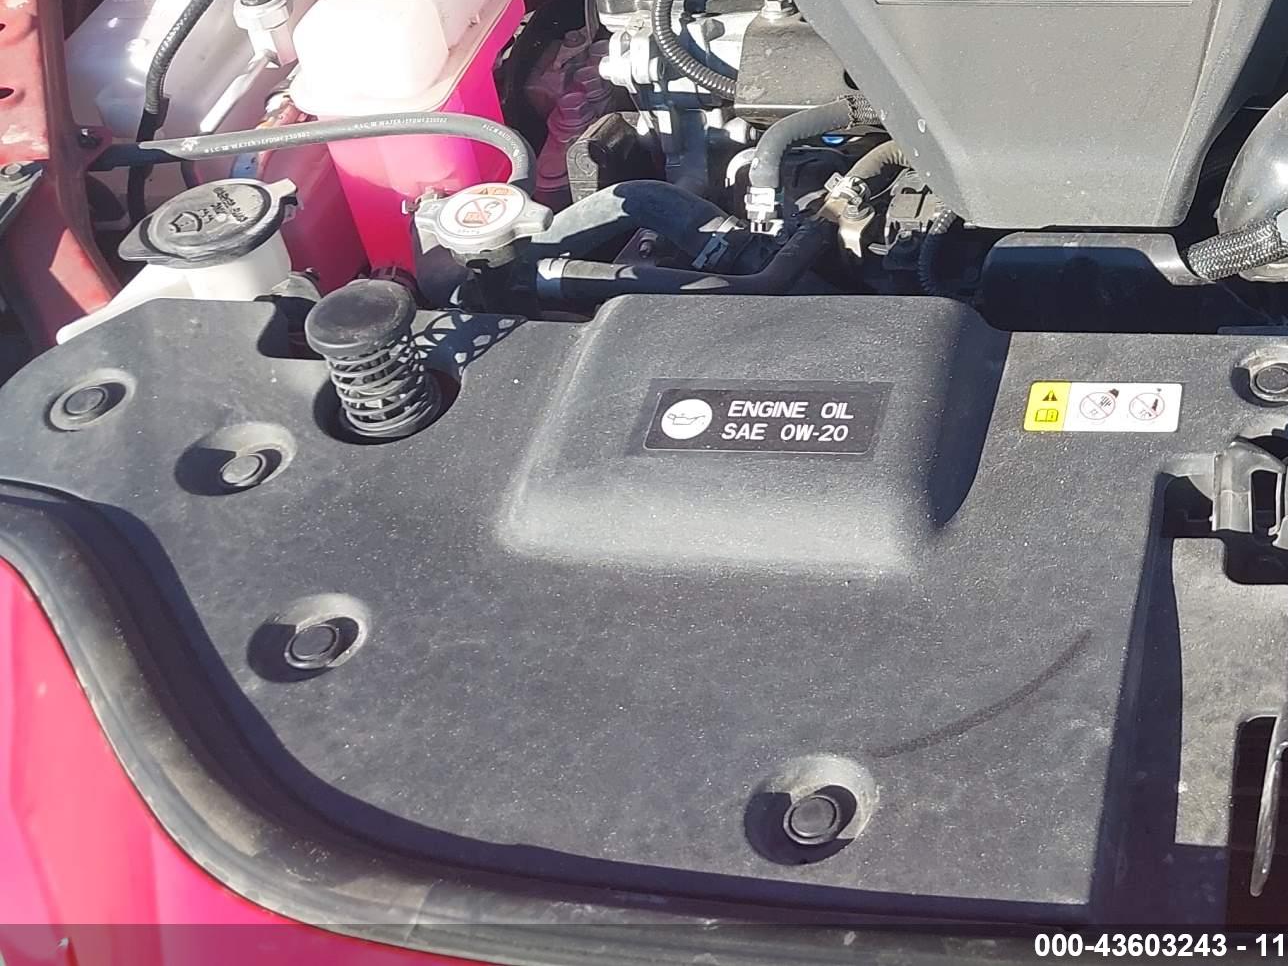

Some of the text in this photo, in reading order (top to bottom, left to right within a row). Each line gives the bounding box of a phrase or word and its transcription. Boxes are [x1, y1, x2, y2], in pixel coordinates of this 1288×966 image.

[728, 400, 854, 419] ENGINE OIL
[721, 423, 849, 442] SAE 0W-20
